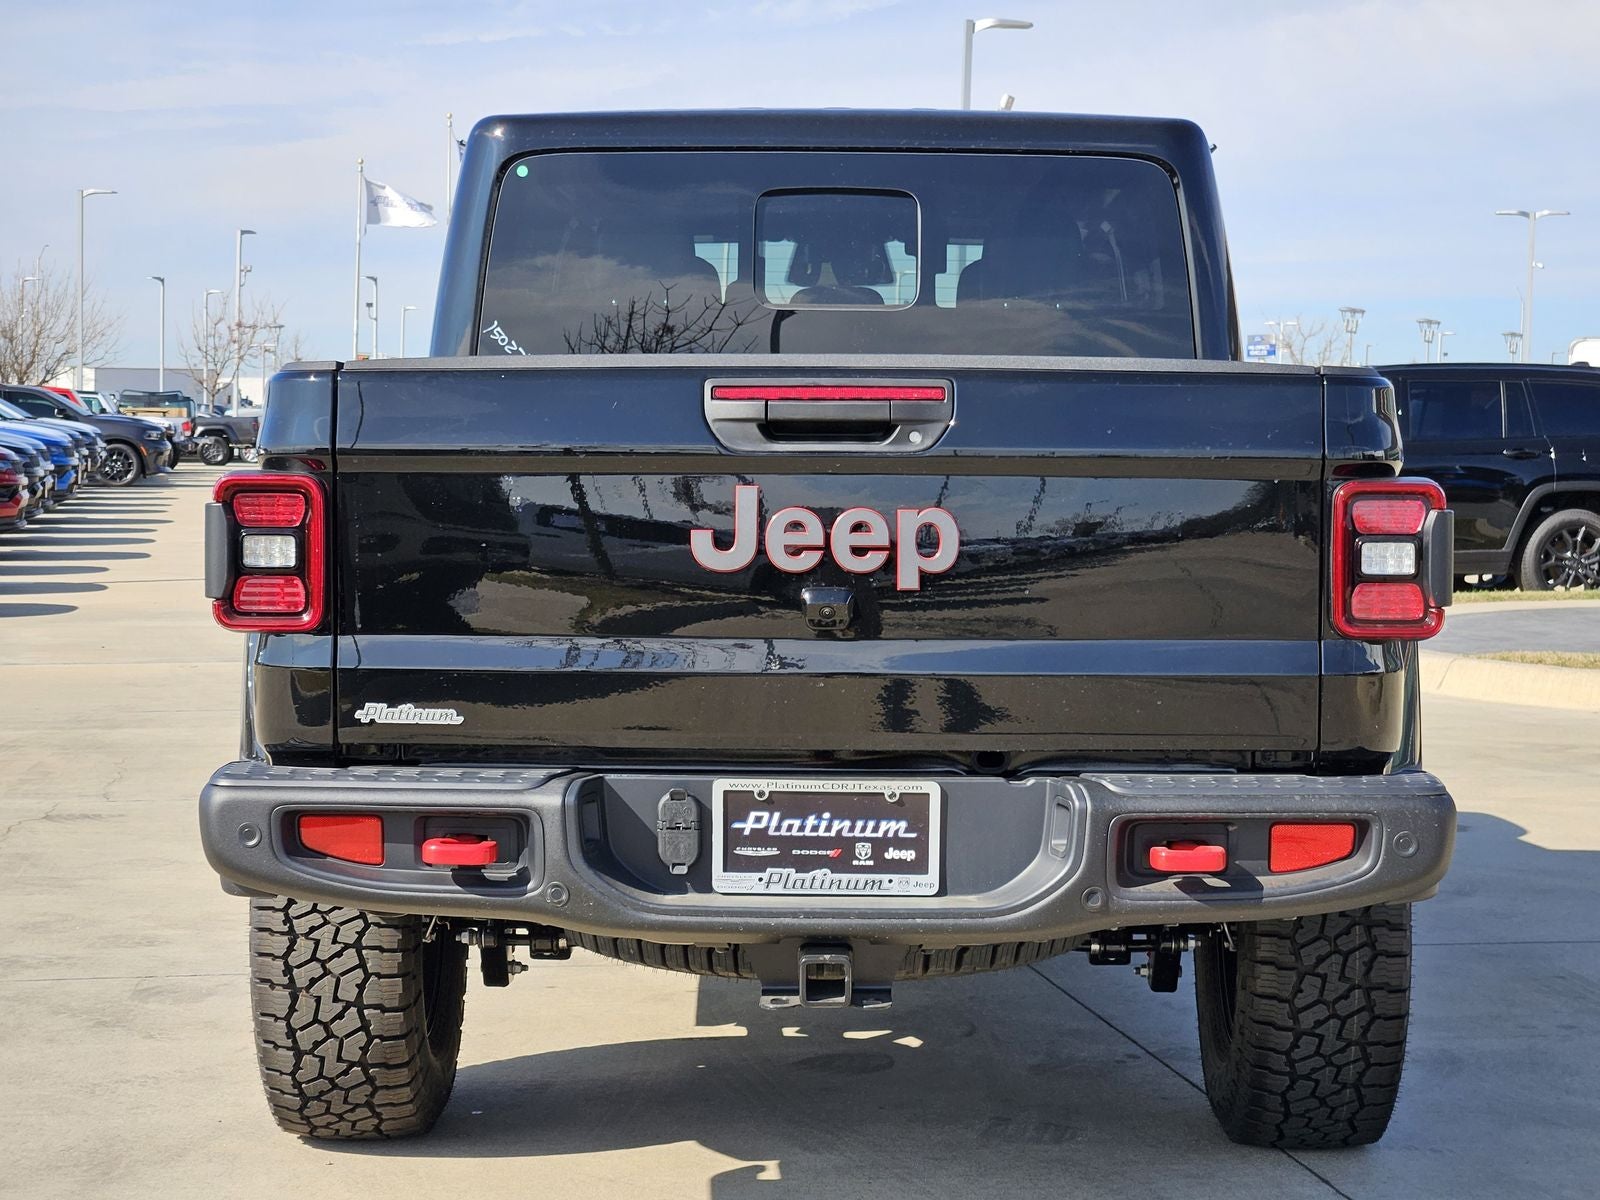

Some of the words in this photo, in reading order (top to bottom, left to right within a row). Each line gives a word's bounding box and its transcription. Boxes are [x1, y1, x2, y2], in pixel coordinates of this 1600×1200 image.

[690, 484, 960, 591] Jeep
[354, 702, 464, 724] Platinum
[728, 781, 923, 792] www.PlatinumCDRJTexas.com
[731, 811, 918, 838] Platinum
[884, 847, 916, 862] Jeep
[765, 871, 893, 891] Platinum
[912, 880, 935, 890] Jeep
